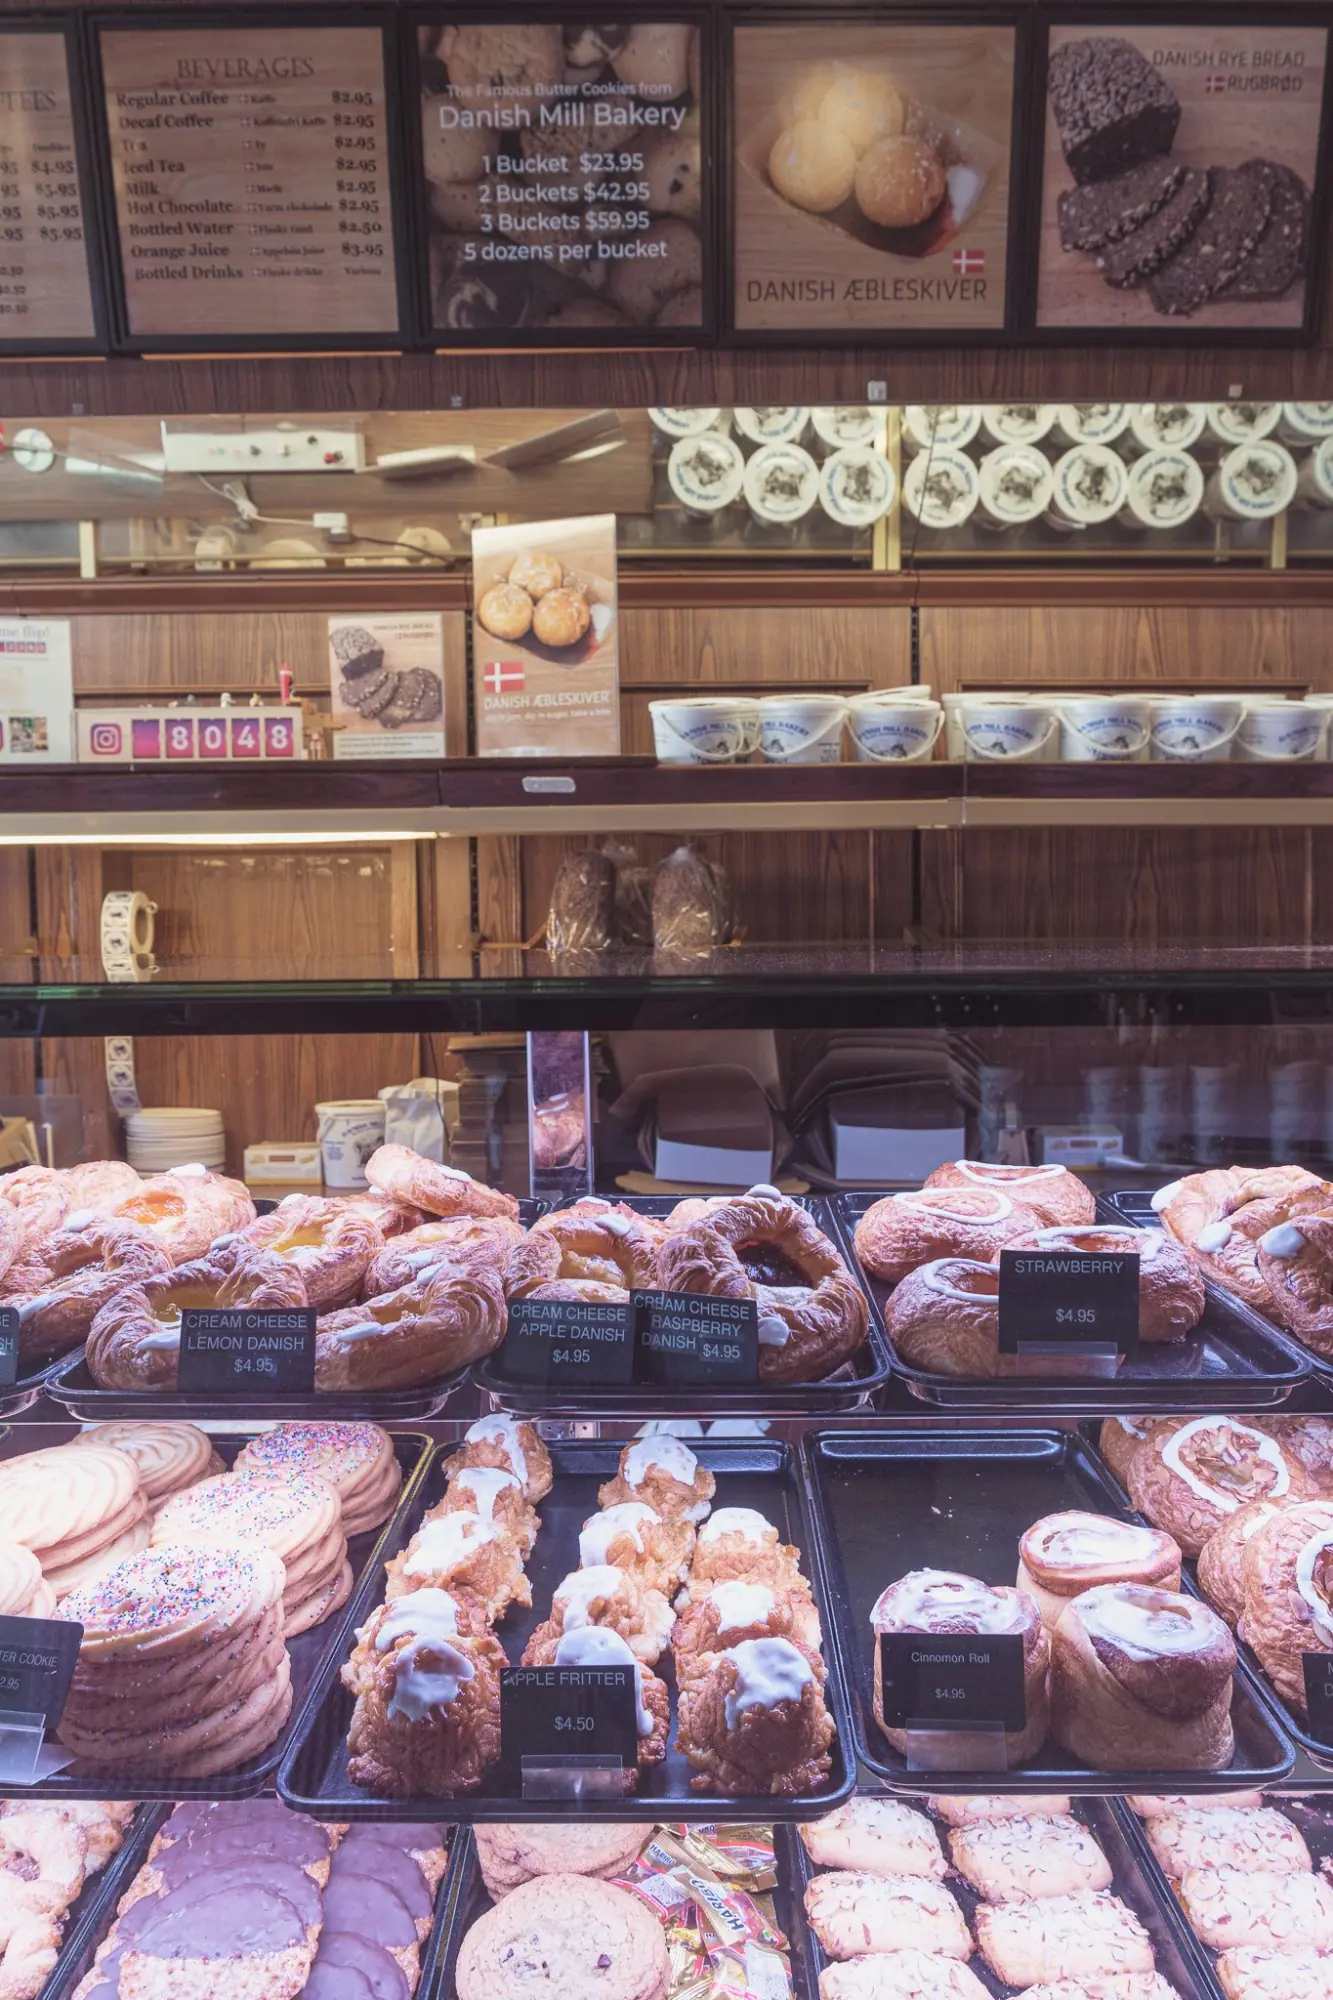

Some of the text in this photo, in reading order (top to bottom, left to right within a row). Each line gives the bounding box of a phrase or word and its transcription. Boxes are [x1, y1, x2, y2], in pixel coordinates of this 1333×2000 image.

[177, 57, 315, 79] BEVERAGES
[1152, 51, 1306, 68] DANISH RYE BREAD
[446, 81, 672, 98] The Famous Butter Cookies from
[116, 91, 177, 109] Regular
[180, 90, 228, 105] Coffee
[332, 90, 373, 106] $2.95
[119, 114, 162, 129] Decaf
[164, 113, 214, 128] Coffee
[333, 113, 375, 129] $2.95
[439, 101, 687, 131] Danish Mill Bakery
[334, 135, 375, 151] $2.95
[160, 160, 186, 173] Tea
[336, 157, 377, 173] $2.95
[482, 152, 645, 173] 1 Bucket $23.95
[126, 180, 376, 196] Milk $2.95
[478, 182, 650, 203] 2 Buckets $42.95
[127, 200, 154, 215] Hot
[158, 199, 233, 214] Chocolate
[339, 198, 379, 213] $2.95
[129, 222, 183, 236] Bottled
[186, 222, 235, 235] Water
[339, 221, 382, 235] $2.50
[480, 211, 650, 232] 3 Buckets $59.95
[131, 244, 186, 260] Orange
[189, 242, 230, 256] Juice
[342, 242, 384, 257] $3.95
[464, 240, 668, 263] 5 dozens per bucket
[135, 265, 188, 280] Bottled
[192, 264, 244, 279] Drinks
[747, 279, 987, 302] DANISH ÆBLESKIVER
[483, 690, 610, 710] DANISH ÆBLESKIVER
[1015, 1260, 1124, 1273] STRAWBERRY
[511, 1304, 626, 1321] CREAM CHEESE
[634, 1294, 750, 1320] CREAM CHEESE
[1056, 1308, 1096, 1323] $4.95
[187, 1315, 307, 1329] CREAM CHEESE
[652, 1315, 742, 1337] RASPBERRY
[519, 1323, 625, 1342] APPLE DANISH
[187, 1336, 304, 1350] LEMON DANISH
[642, 1333, 741, 1360] DANISH $4.95
[552, 1349, 590, 1363] $4.95
[234, 1357, 274, 1374] $4.95
[19, 1652, 58, 1667] COOKIE
[969, 1653, 990, 1664] Roll
[504, 1672, 625, 1686] APPLE FRITTER
[935, 1688, 966, 1699] $4.95
[554, 1716, 595, 1731] $4.50
